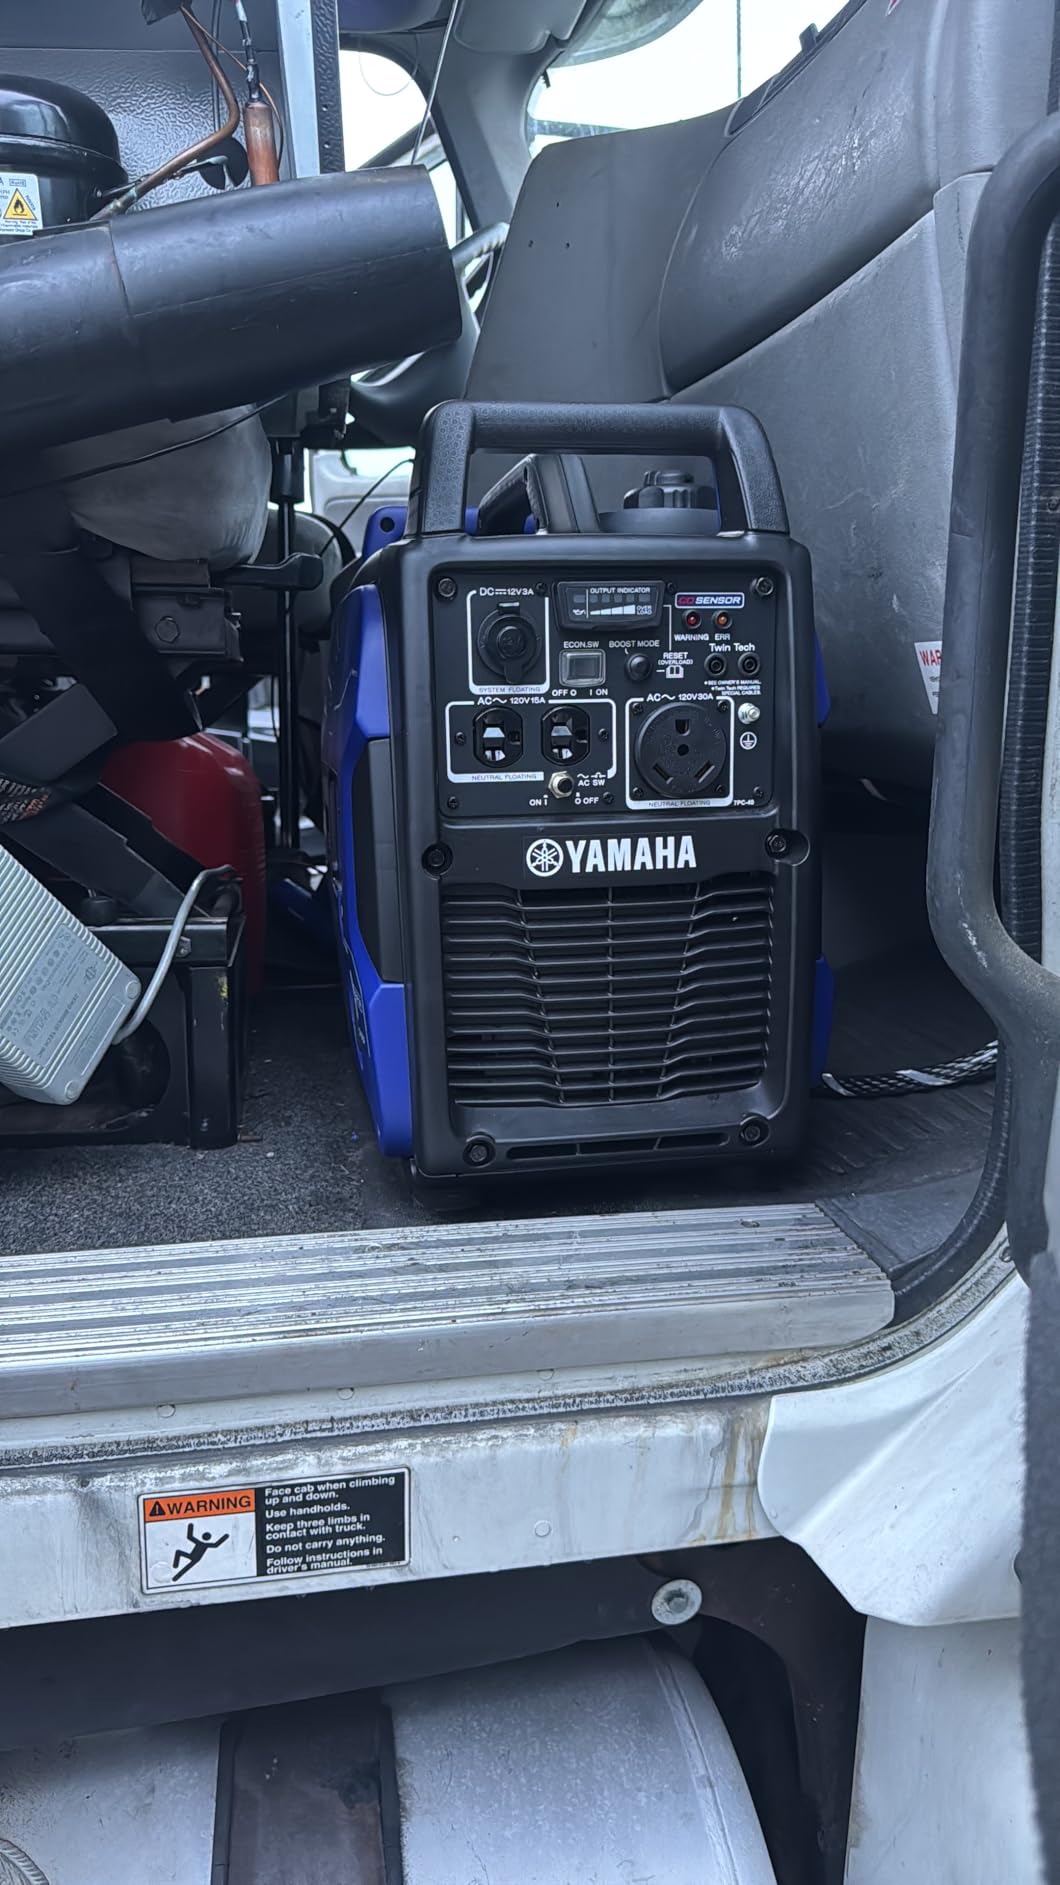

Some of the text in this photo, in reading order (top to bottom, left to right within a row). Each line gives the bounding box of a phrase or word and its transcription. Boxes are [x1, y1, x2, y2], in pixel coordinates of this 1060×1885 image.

[479, 587, 494, 596] DC
[695, 596, 741, 605] SENSOR
[674, 633, 709, 641] WARNING
[715, 633, 730, 641] ERR
[609, 639, 660, 648] BOOST MODE
[709, 642, 756, 652] Twin Tech
[663, 652, 688, 660] RESET
[595, 688, 608, 696] ON
[477, 697, 492, 705] AC
[646, 693, 661, 702] AC
[582, 796, 599, 804] OFF
[565, 835, 697, 873] YAMAHA
[265, 1476, 395, 1497] Face cab when climbing
[265, 1490, 339, 1506] up and down.
[167, 1495, 252, 1515] WARNING
[265, 1502, 350, 1519] Use handholds.
[265, 1513, 371, 1532] Keep three limbs in
[265, 1522, 366, 1540] contact with truck.
[266, 1534, 386, 1554] Do not carry anything.
[266, 1546, 383, 1567] Follow instructions in
[266, 1558, 353, 1575] driver's manual.
